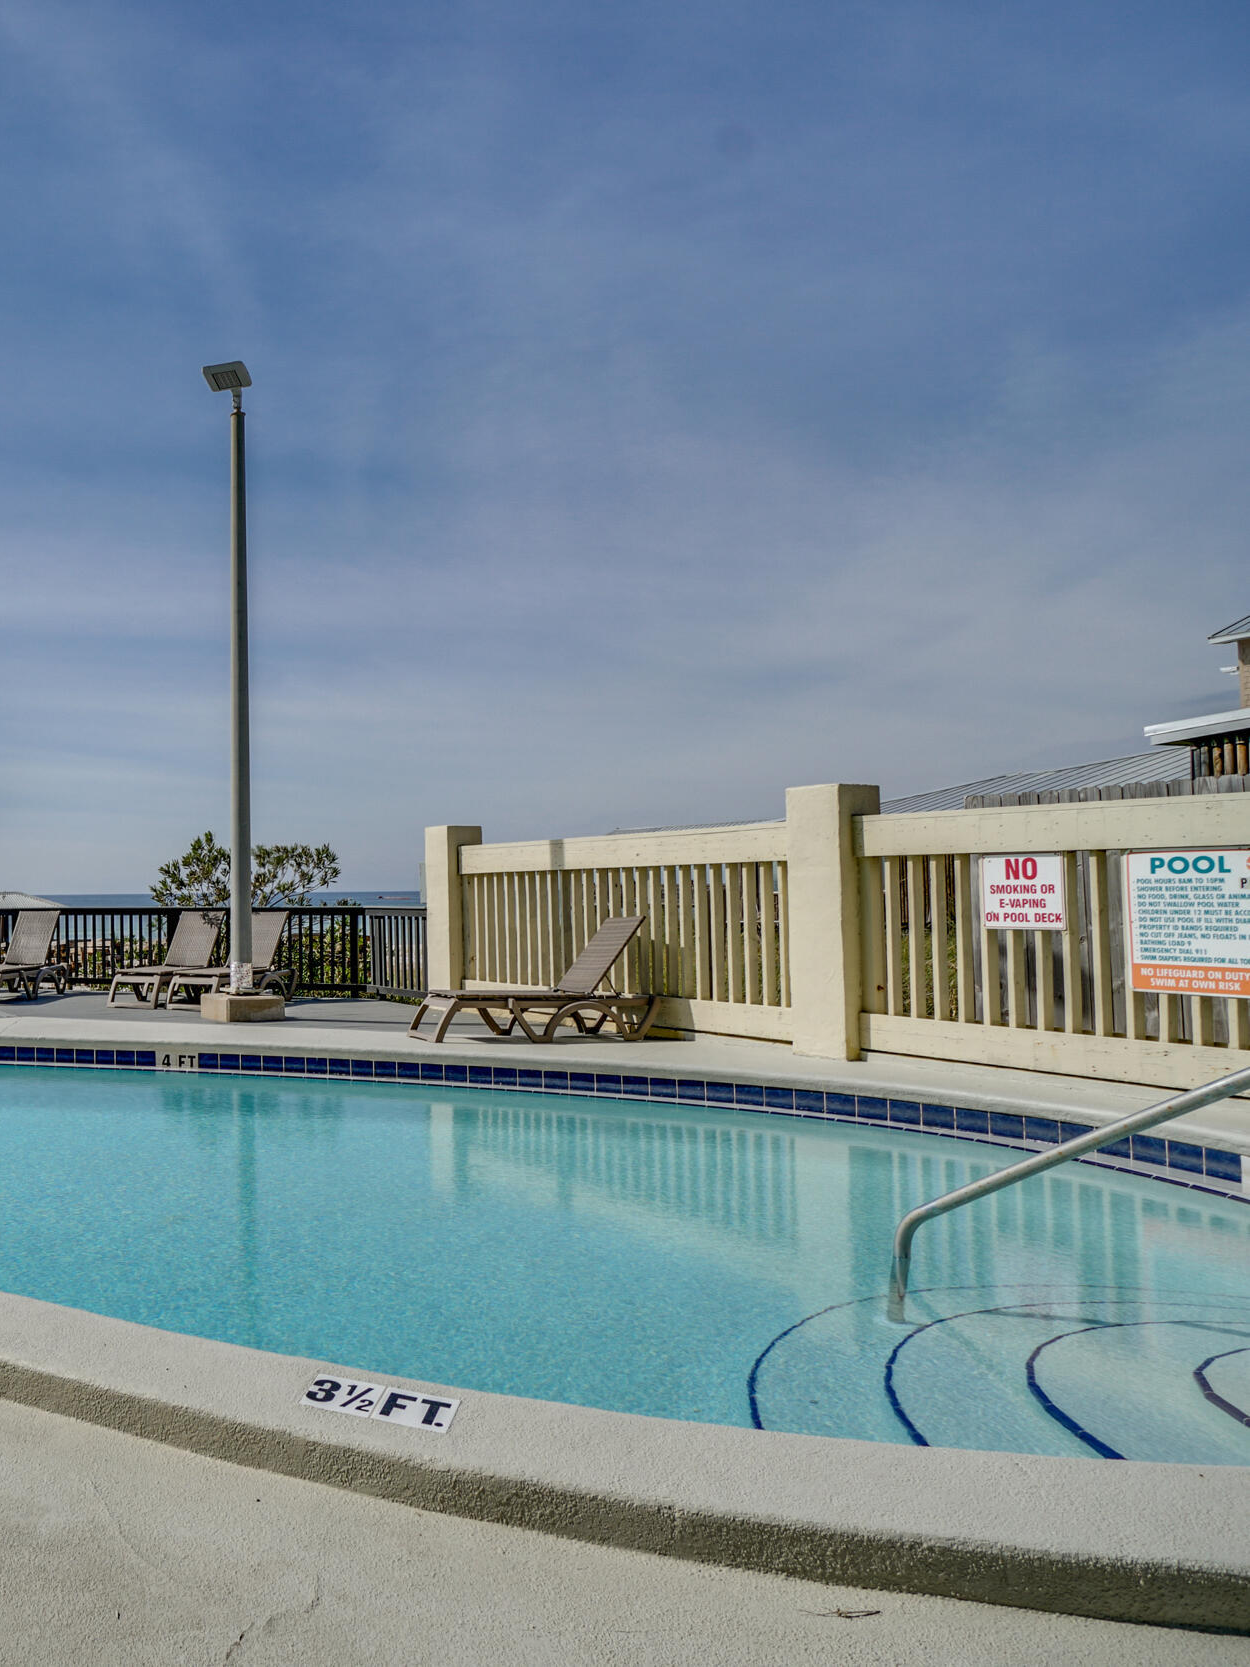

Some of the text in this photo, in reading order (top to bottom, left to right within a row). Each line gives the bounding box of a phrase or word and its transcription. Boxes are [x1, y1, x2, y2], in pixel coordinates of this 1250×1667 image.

[1005, 857, 1038, 880] NO
[1150, 856, 1231, 874] POOL
[990, 884, 1055, 894] SMOKING OR
[999, 898, 1046, 908] E-VAPING
[986, 912, 1062, 923] ON POOL DECK
[1140, 968, 1250, 981] NO LIFEGUARD ON DUTY
[1150, 978, 1241, 991] SWIM AT OWN RISK
[162, 1054, 196, 1068] 4 FT
